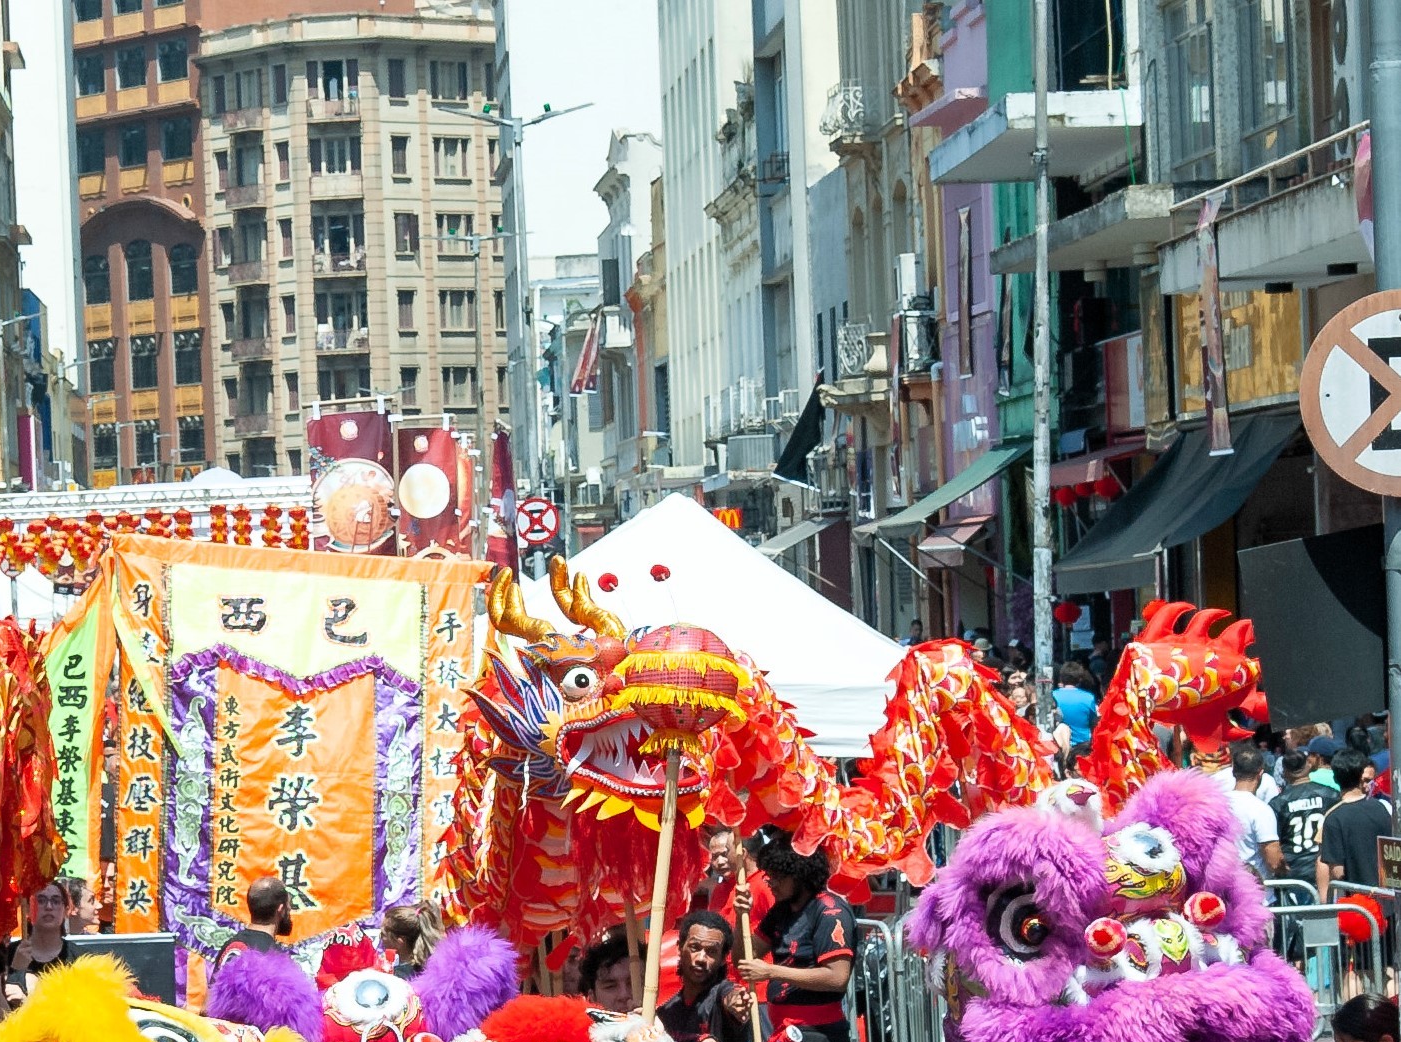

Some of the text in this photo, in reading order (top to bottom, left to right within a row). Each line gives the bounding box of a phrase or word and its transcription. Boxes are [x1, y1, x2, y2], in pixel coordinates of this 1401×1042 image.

[268, 704, 319, 911] 李榮基
[1289, 813, 1324, 853] 10
